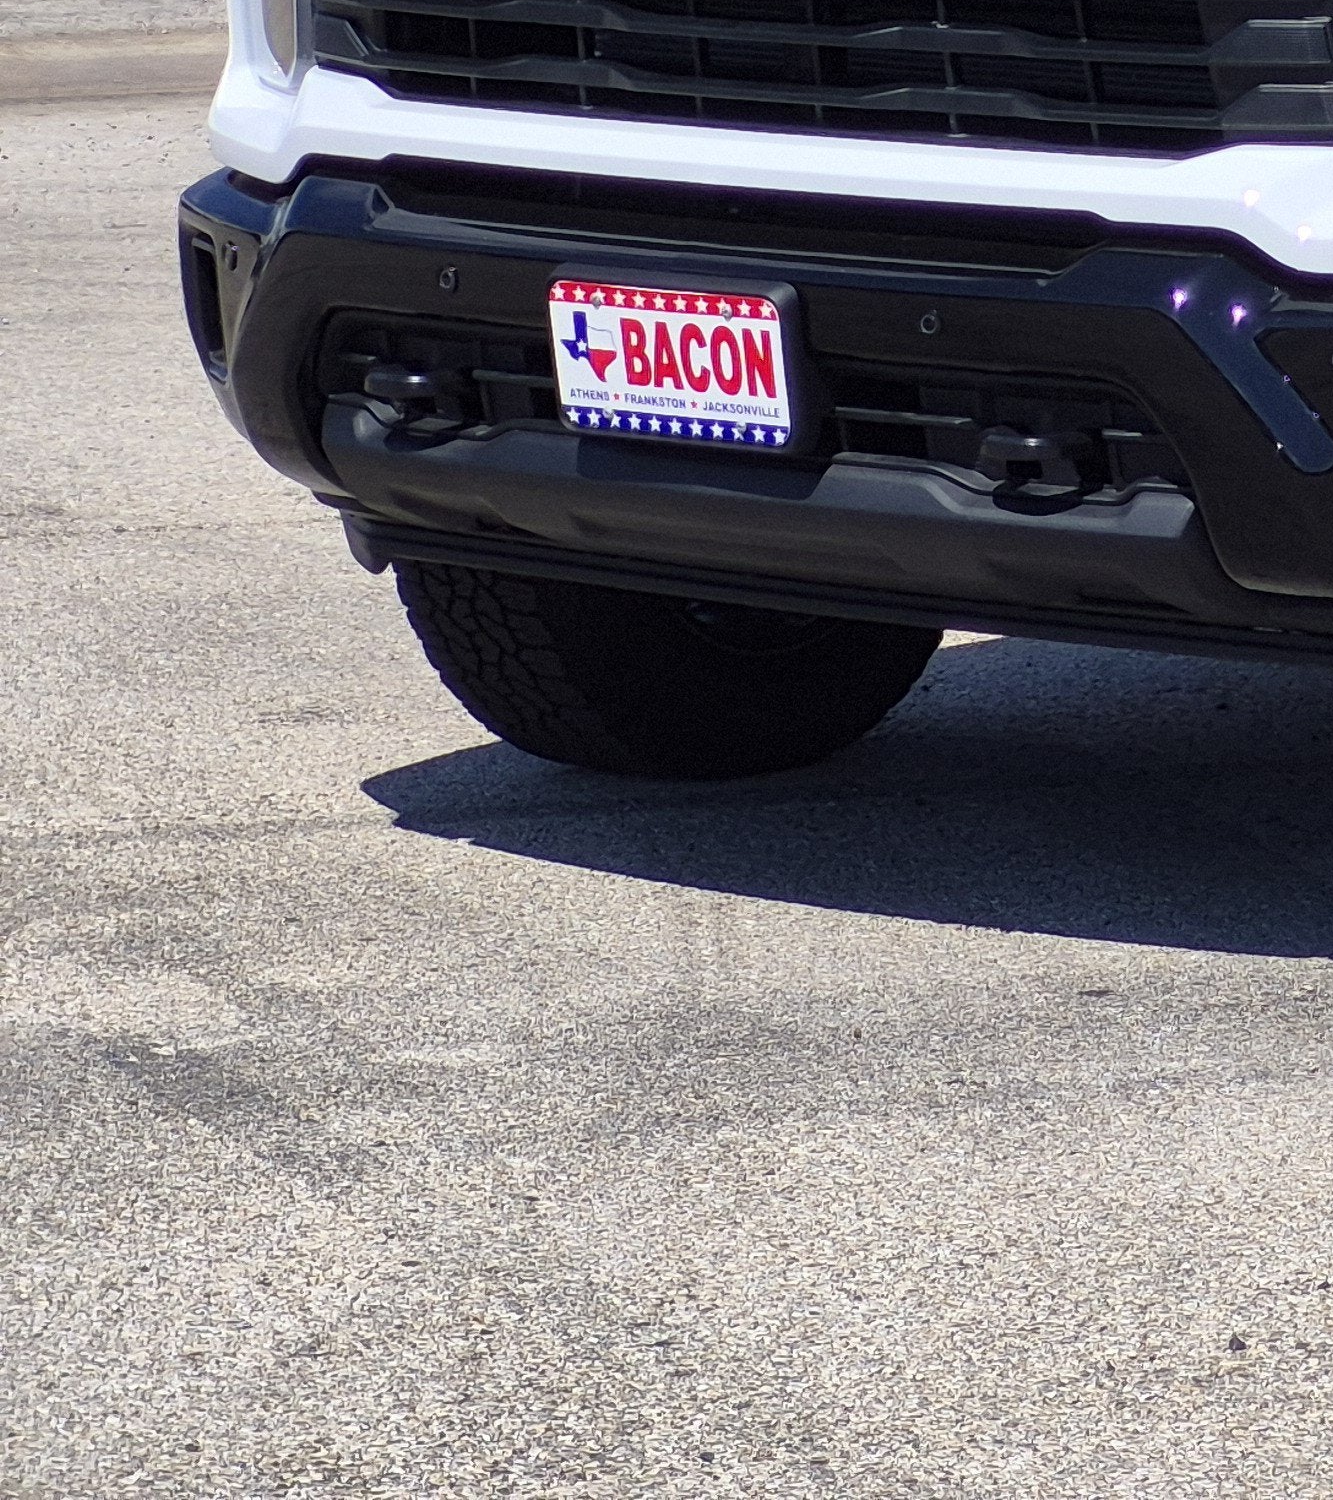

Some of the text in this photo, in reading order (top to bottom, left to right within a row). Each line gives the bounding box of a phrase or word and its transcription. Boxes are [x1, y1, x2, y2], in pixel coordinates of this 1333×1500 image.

[619, 317, 777, 398] BACON
[569, 386, 781, 419] ATHENS FRANKSTON JACKSONVILLE
